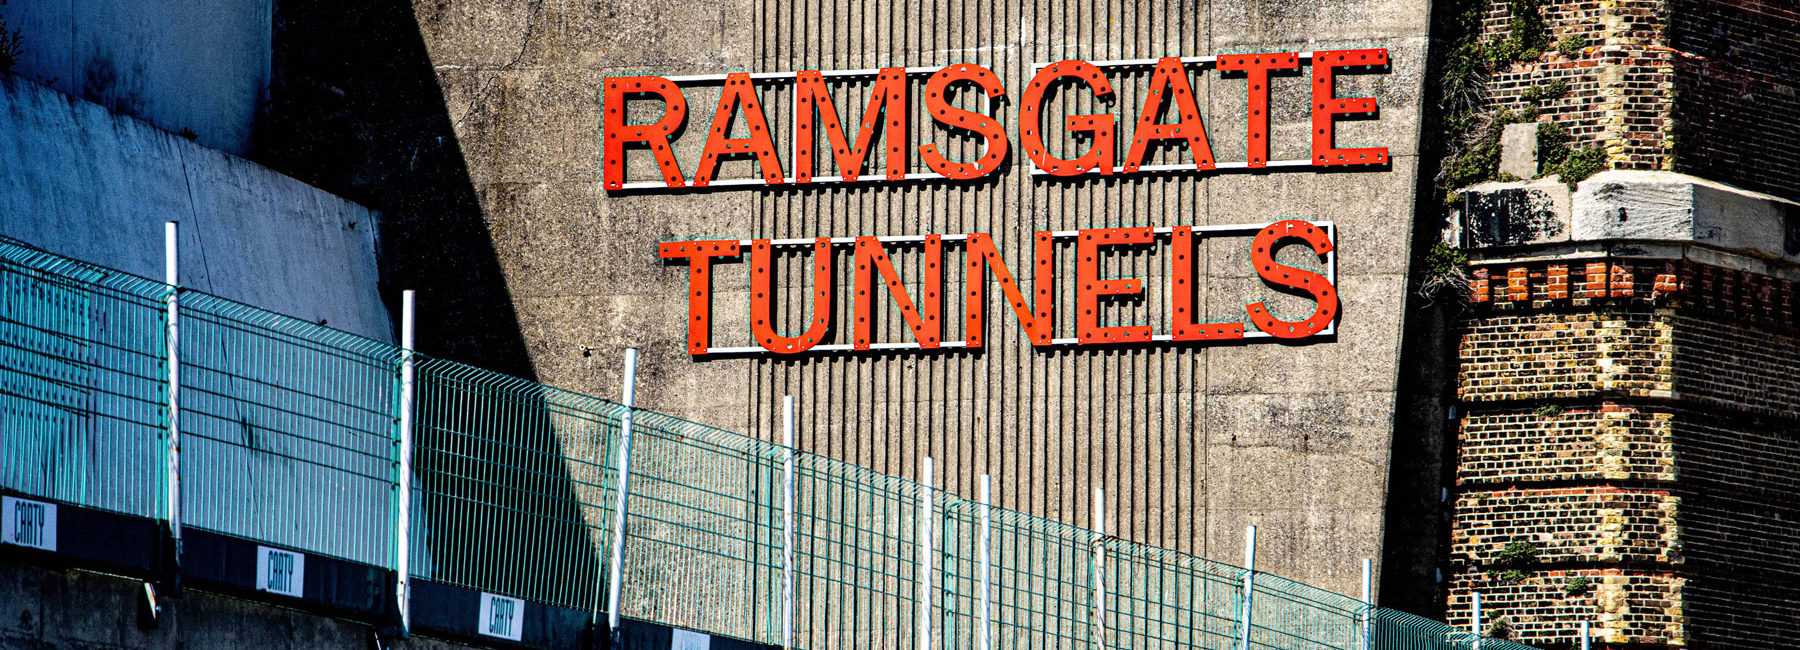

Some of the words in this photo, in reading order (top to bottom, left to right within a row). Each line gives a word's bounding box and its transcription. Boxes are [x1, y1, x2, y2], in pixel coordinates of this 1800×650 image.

[604, 48, 1389, 190] RAMSGATE
[659, 220, 1338, 355] TUNNELS
[14, 500, 45, 547] CARTY
[267, 550, 294, 593] CARTY
[489, 596, 515, 637] CARTY
